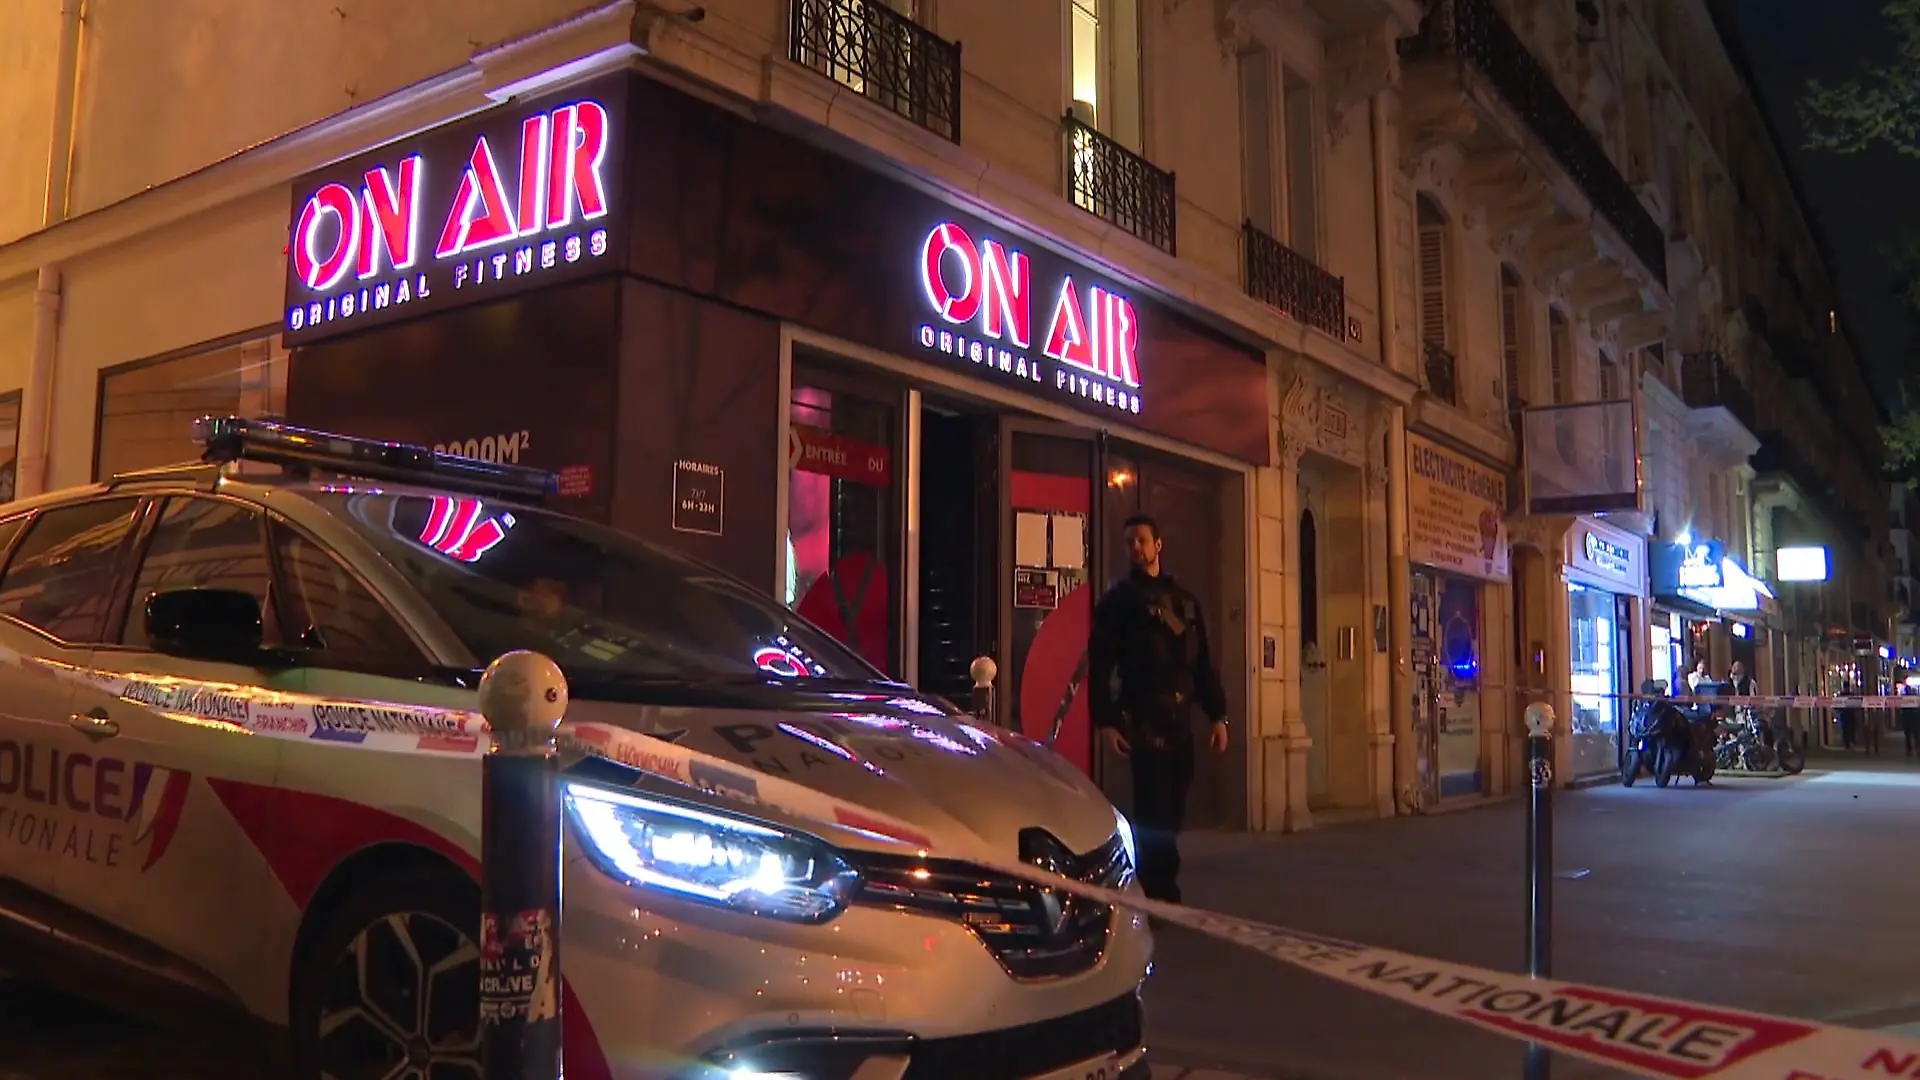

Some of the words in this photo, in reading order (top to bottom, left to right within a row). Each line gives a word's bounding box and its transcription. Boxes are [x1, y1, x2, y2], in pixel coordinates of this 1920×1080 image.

[293, 153, 422, 291] ON
[434, 100, 609, 260] AIR
[288, 272, 431, 331] ORIGINAL
[453, 228, 609, 290] FITNESS
[921, 222, 1031, 350] ON
[1042, 273, 1141, 388] AIR
[920, 324, 1043, 383] ORIGINAL
[1055, 367, 1141, 415] FITNESS
[678, 459, 720, 476] HORAIRES
[805, 443, 848, 466] ENTRÉE
[867, 456, 884, 473] DU
[1350, 960, 1740, 1062] NATIONALE
